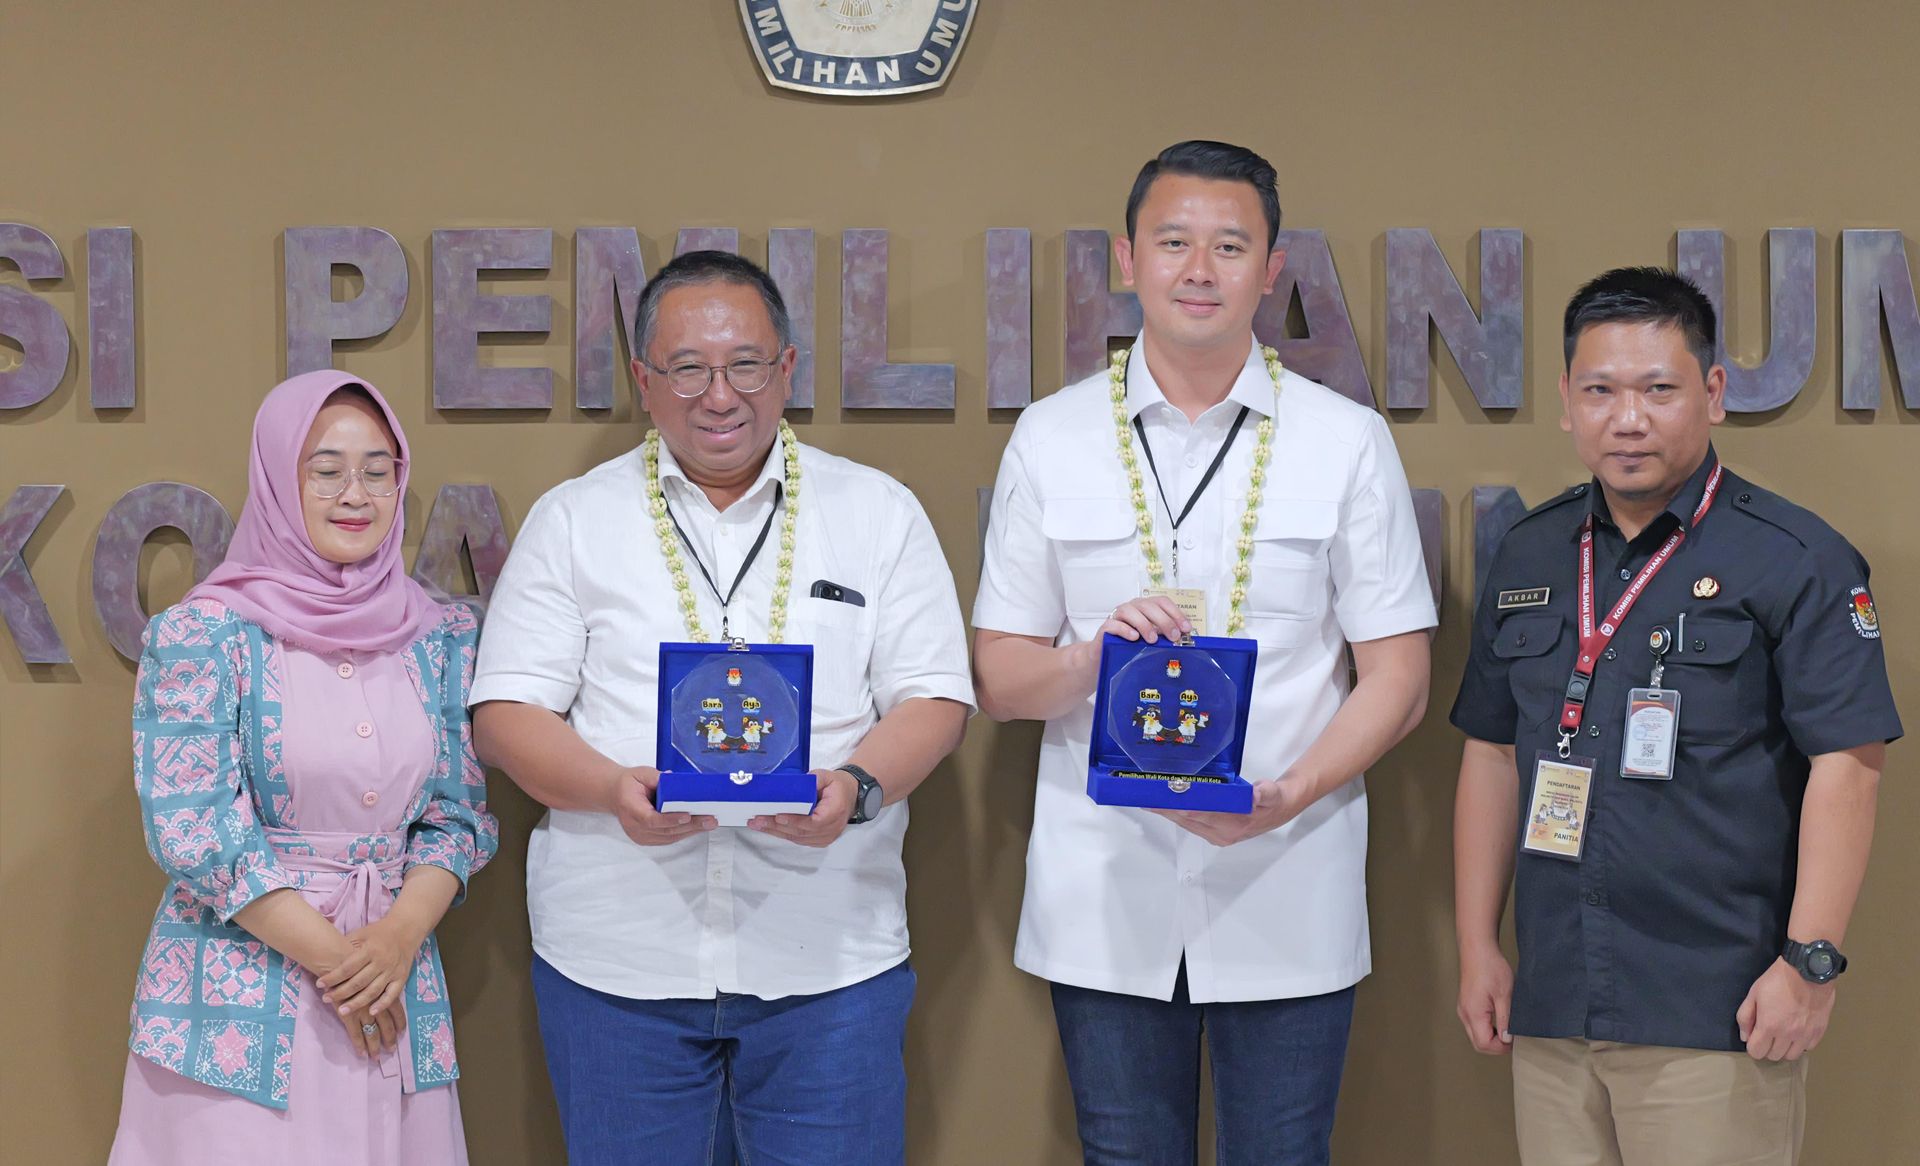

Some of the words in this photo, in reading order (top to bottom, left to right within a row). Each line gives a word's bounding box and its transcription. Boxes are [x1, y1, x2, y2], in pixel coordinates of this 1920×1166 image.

[1612, 593, 1633, 620] KOMISI
[1631, 556, 1662, 594] PEMILIHAN
[1660, 535, 1680, 557] UMUM
[1508, 593, 1539, 602] AKBAR
[1583, 615, 1591, 638] UMUM
[1181, 693, 1198, 702] Aya
[702, 700, 722, 708] Bara
[743, 700, 760, 709] Aya
[1554, 832, 1579, 842] PANITIA
